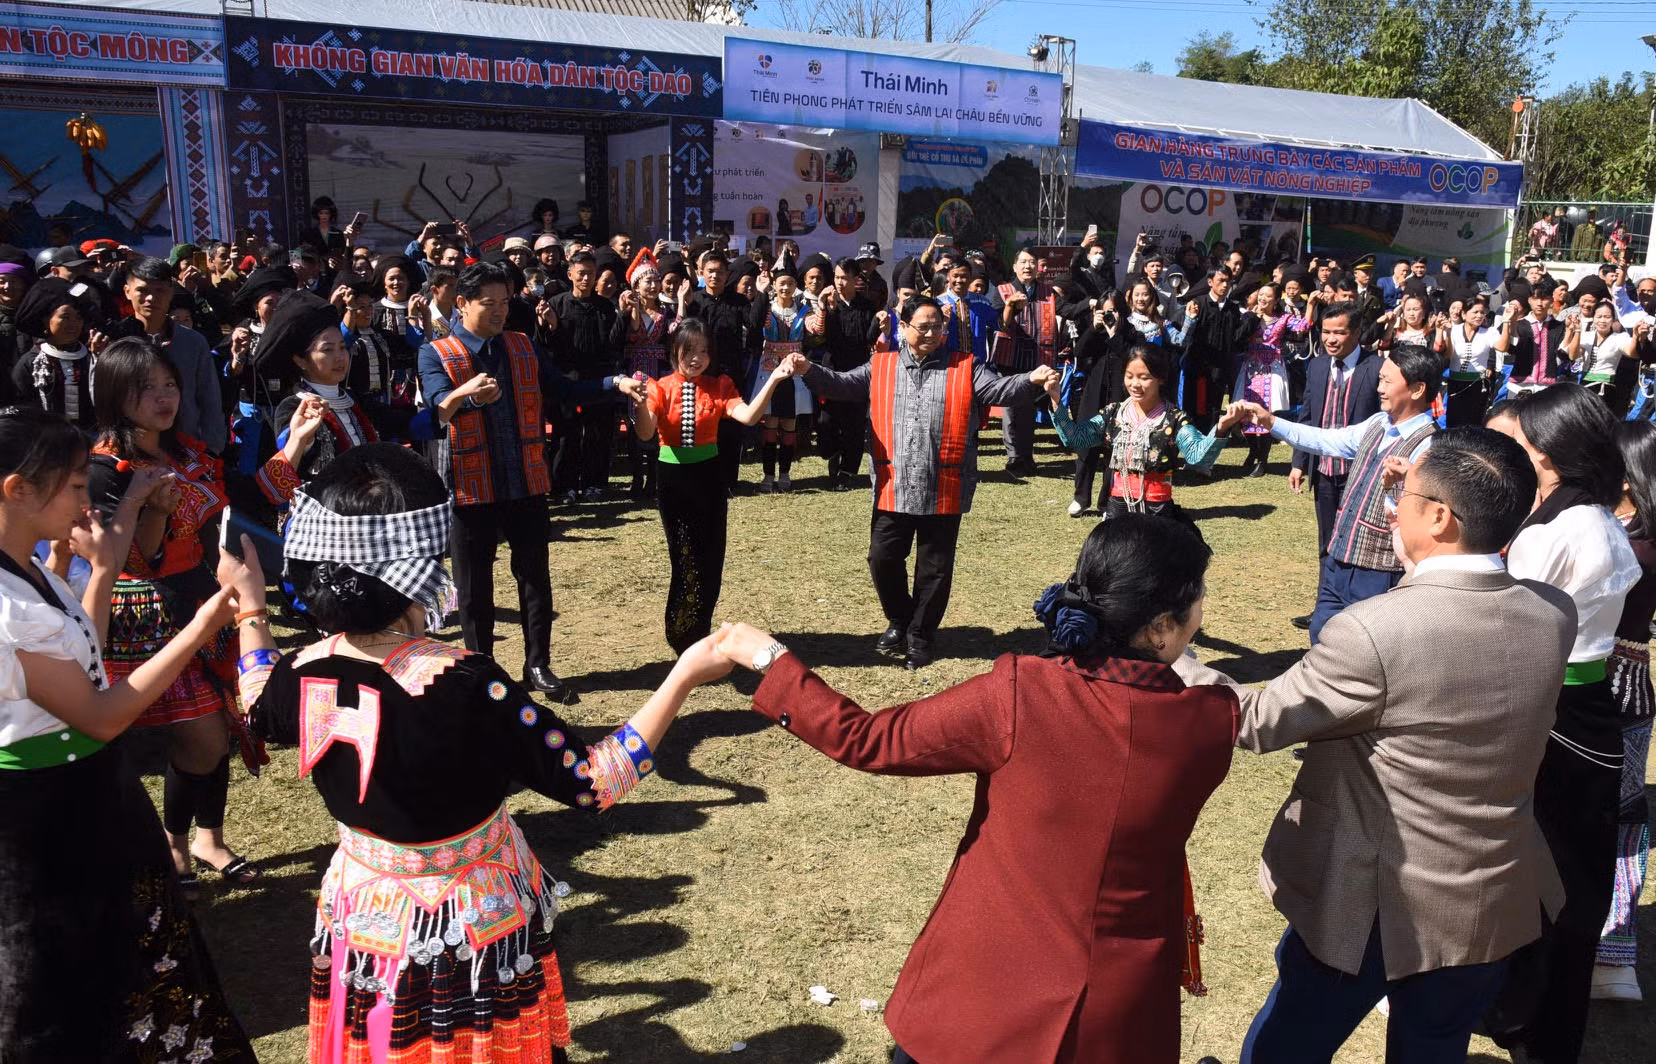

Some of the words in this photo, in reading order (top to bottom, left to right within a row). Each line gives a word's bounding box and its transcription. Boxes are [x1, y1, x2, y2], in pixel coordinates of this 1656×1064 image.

[27, 25, 90, 62] TỘC
[97, 31, 189, 65] MÔNG
[273, 42, 366, 73] KHÔNG
[372, 51, 434, 77] GIAN
[439, 53, 489, 81] VĂN
[495, 58, 543, 85] HÓA
[548, 61, 596, 88] DÂN
[602, 65, 644, 95] TỘC
[649, 72, 692, 95] DAO
[861, 70, 900, 91] Thái
[905, 75, 948, 96] Minh
[750, 89, 780, 103] TIÊN
[783, 93, 828, 108] PHONG
[831, 96, 865, 111] PHÁT
[906, 102, 932, 118] SÂM
[935, 107, 952, 119] LAI
[956, 108, 985, 122] CHÂU
[1013, 113, 1043, 127] VỮNG
[722, 168, 742, 178] phát
[1115, 132, 1162, 153] GIAN
[1165, 136, 1215, 159] HÀNG
[1216, 145, 1275, 164] TRƯNG
[1278, 149, 1310, 169] BÀY
[1313, 153, 1343, 171] CÁC
[1344, 154, 1377, 174] SẢN
[1379, 156, 1421, 177] PHẨM
[1160, 158, 1185, 180] VÀ
[1188, 161, 1226, 183] SẢN
[1228, 165, 1263, 189] VẬT
[1264, 171, 1311, 190] NÔNG
[1313, 174, 1371, 197] NGHIỆP
[1429, 162, 1499, 195] OCOP
[1140, 184, 1226, 216] OCOP
